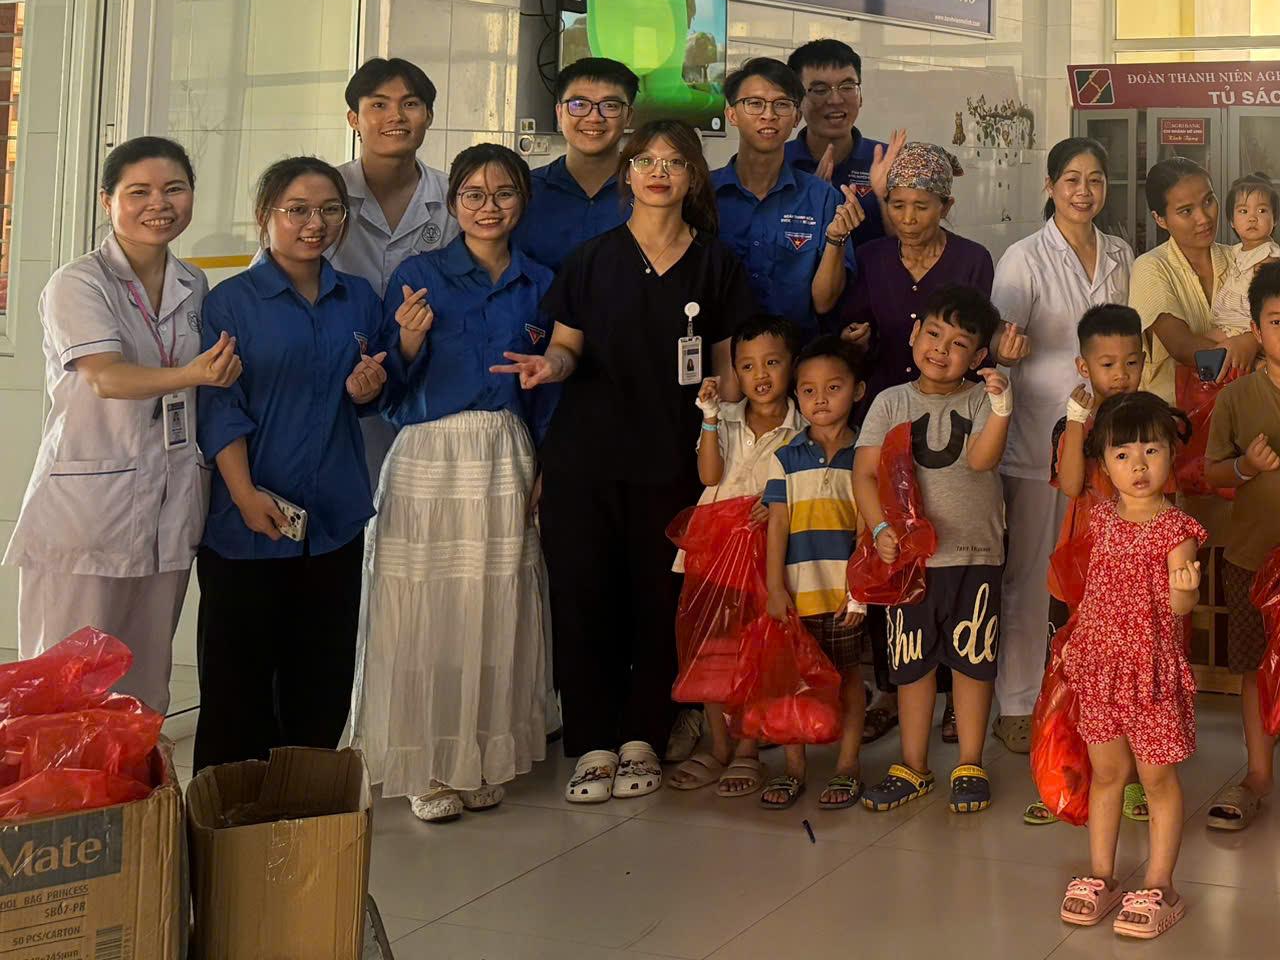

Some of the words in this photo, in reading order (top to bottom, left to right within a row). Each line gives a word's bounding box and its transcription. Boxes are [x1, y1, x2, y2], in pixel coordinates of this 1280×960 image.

[1127, 71, 1166, 84] ĐOÀN
[1168, 72, 1216, 84] THANH
[1219, 69, 1253, 83] NIÊN
[1208, 85, 1235, 105] TỦ
[24, 895, 42, 906] BAG
[47, 885, 89, 901] PRINCESS
